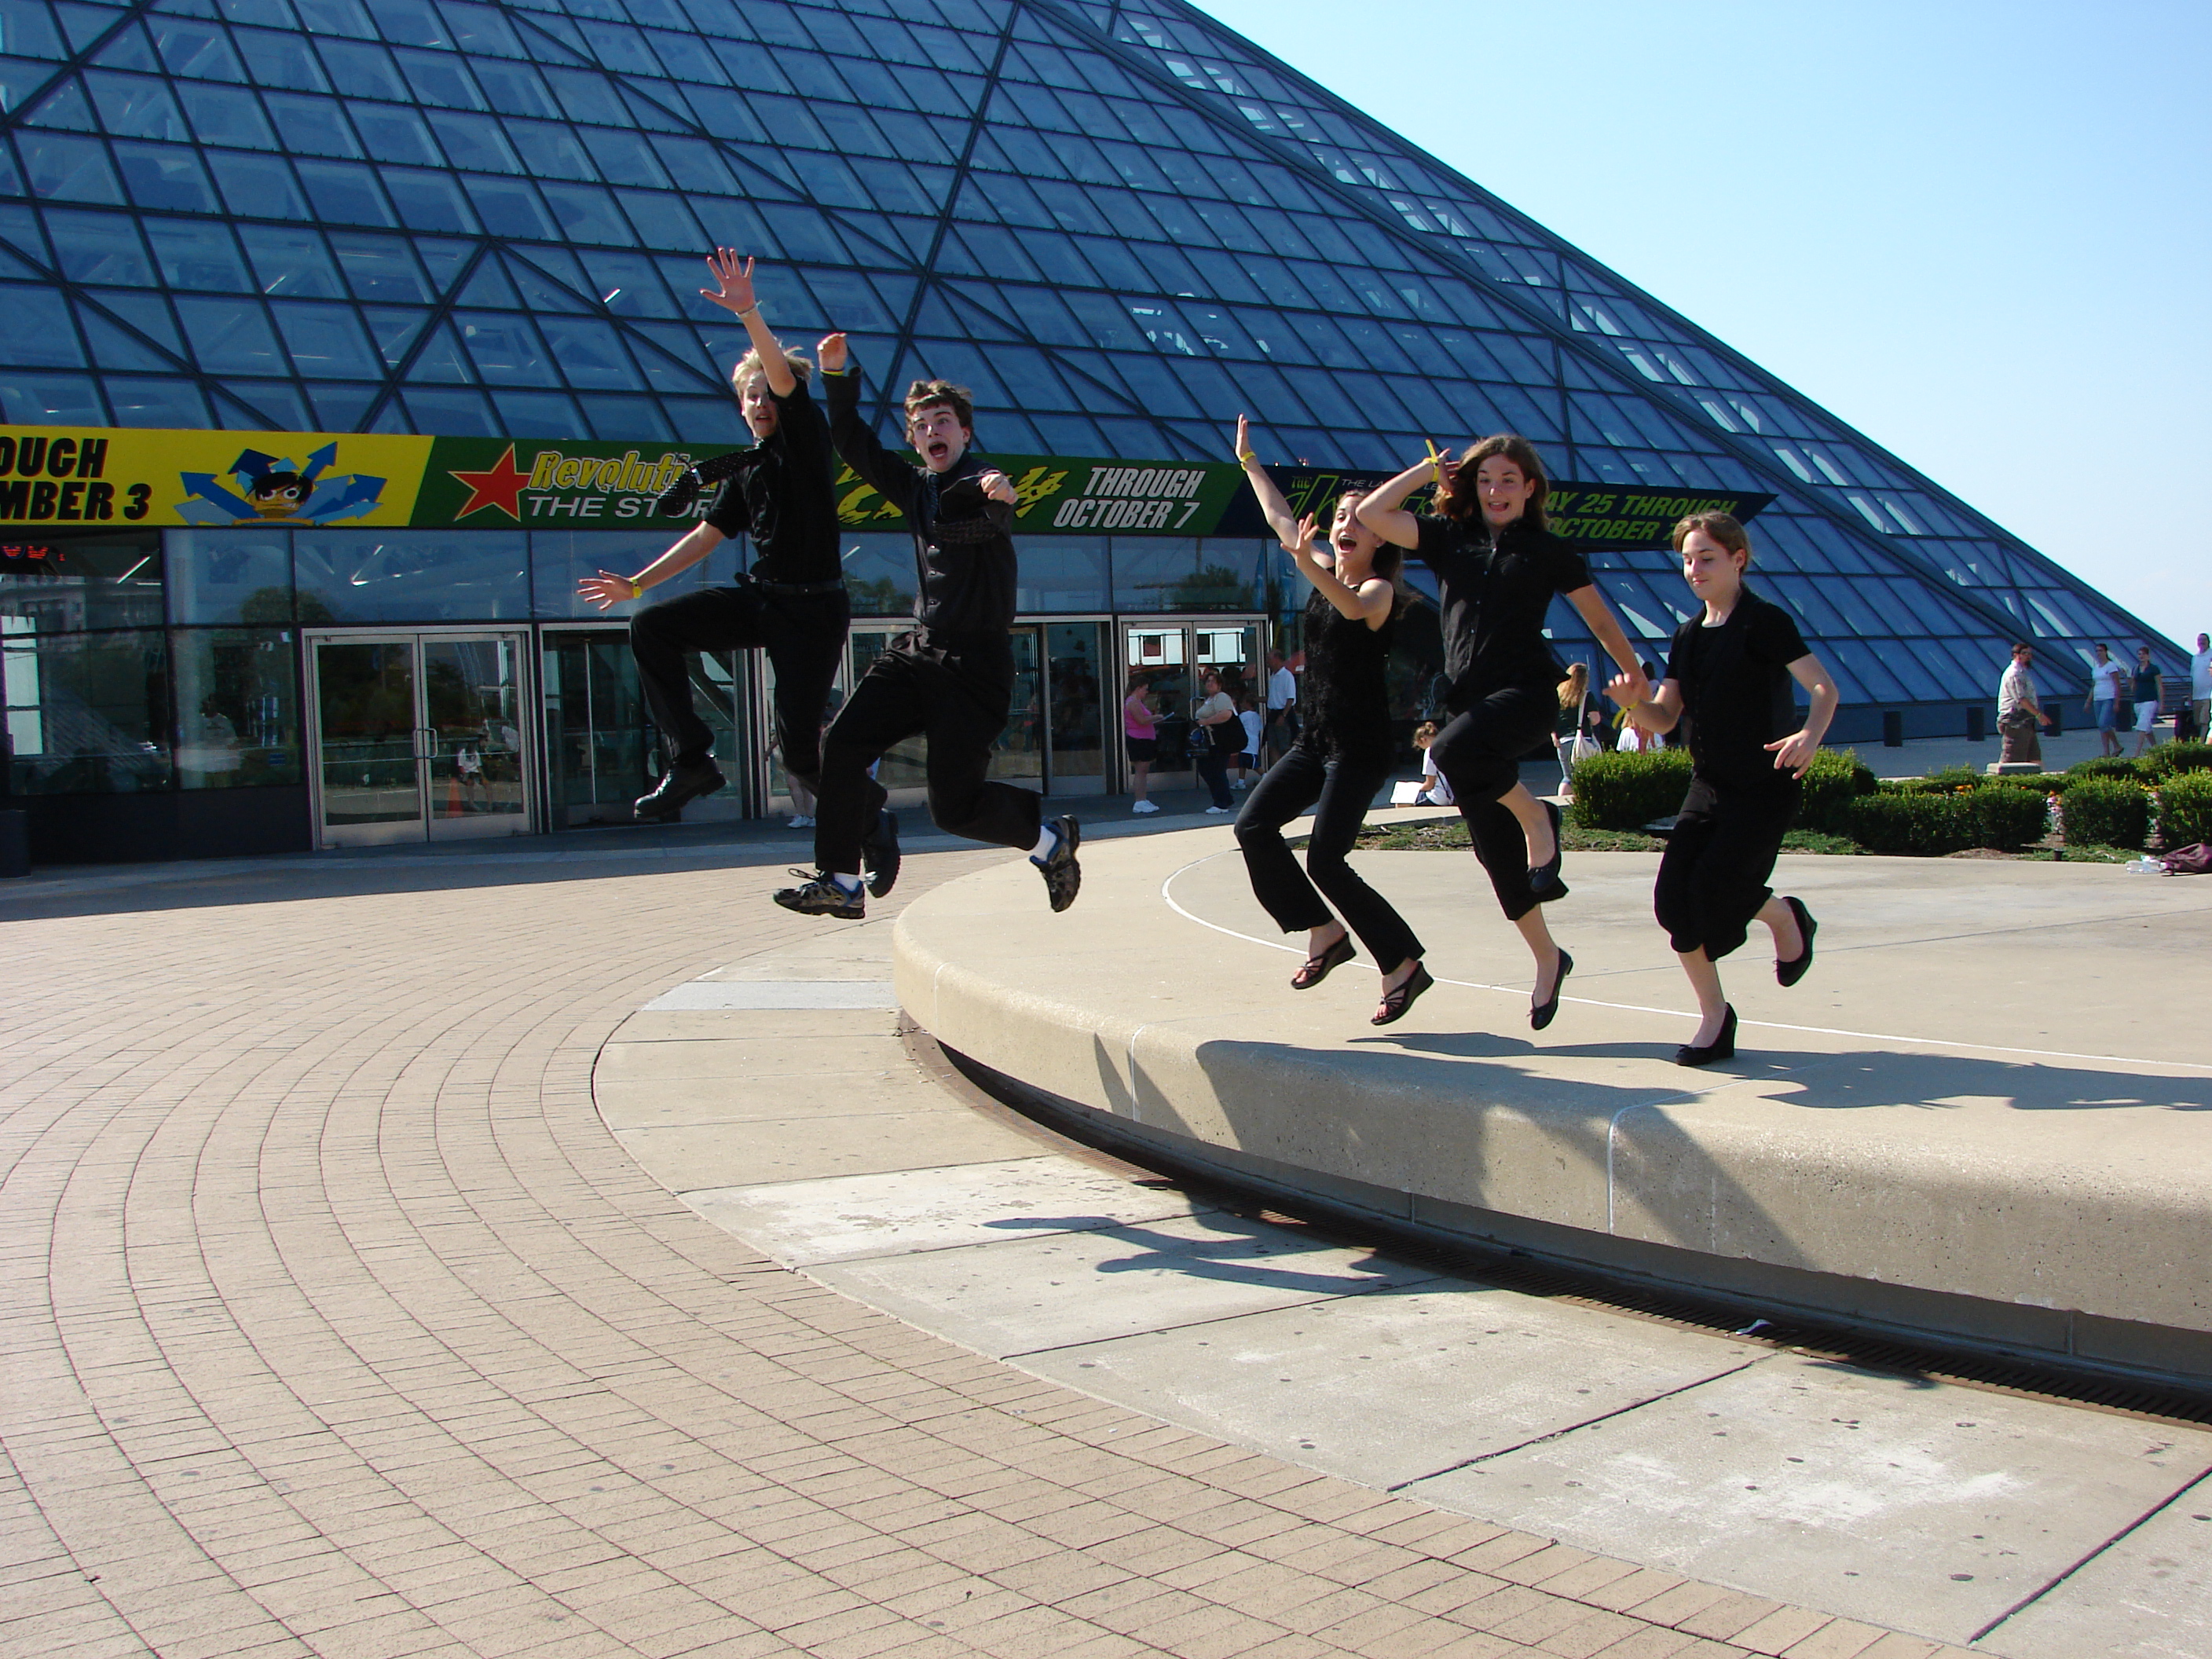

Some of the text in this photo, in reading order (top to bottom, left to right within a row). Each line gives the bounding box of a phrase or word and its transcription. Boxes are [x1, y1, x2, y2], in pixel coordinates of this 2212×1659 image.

[529, 451, 719, 493] Revoluti
[1083, 467, 1206, 498] THROUGH
[1342, 478, 1367, 488] THE
[123, 483, 152, 520] 3
[528, 496, 606, 517] THE
[1053, 499, 1200, 529] OCTOBER 7
[1577, 493, 1617, 514] 25
